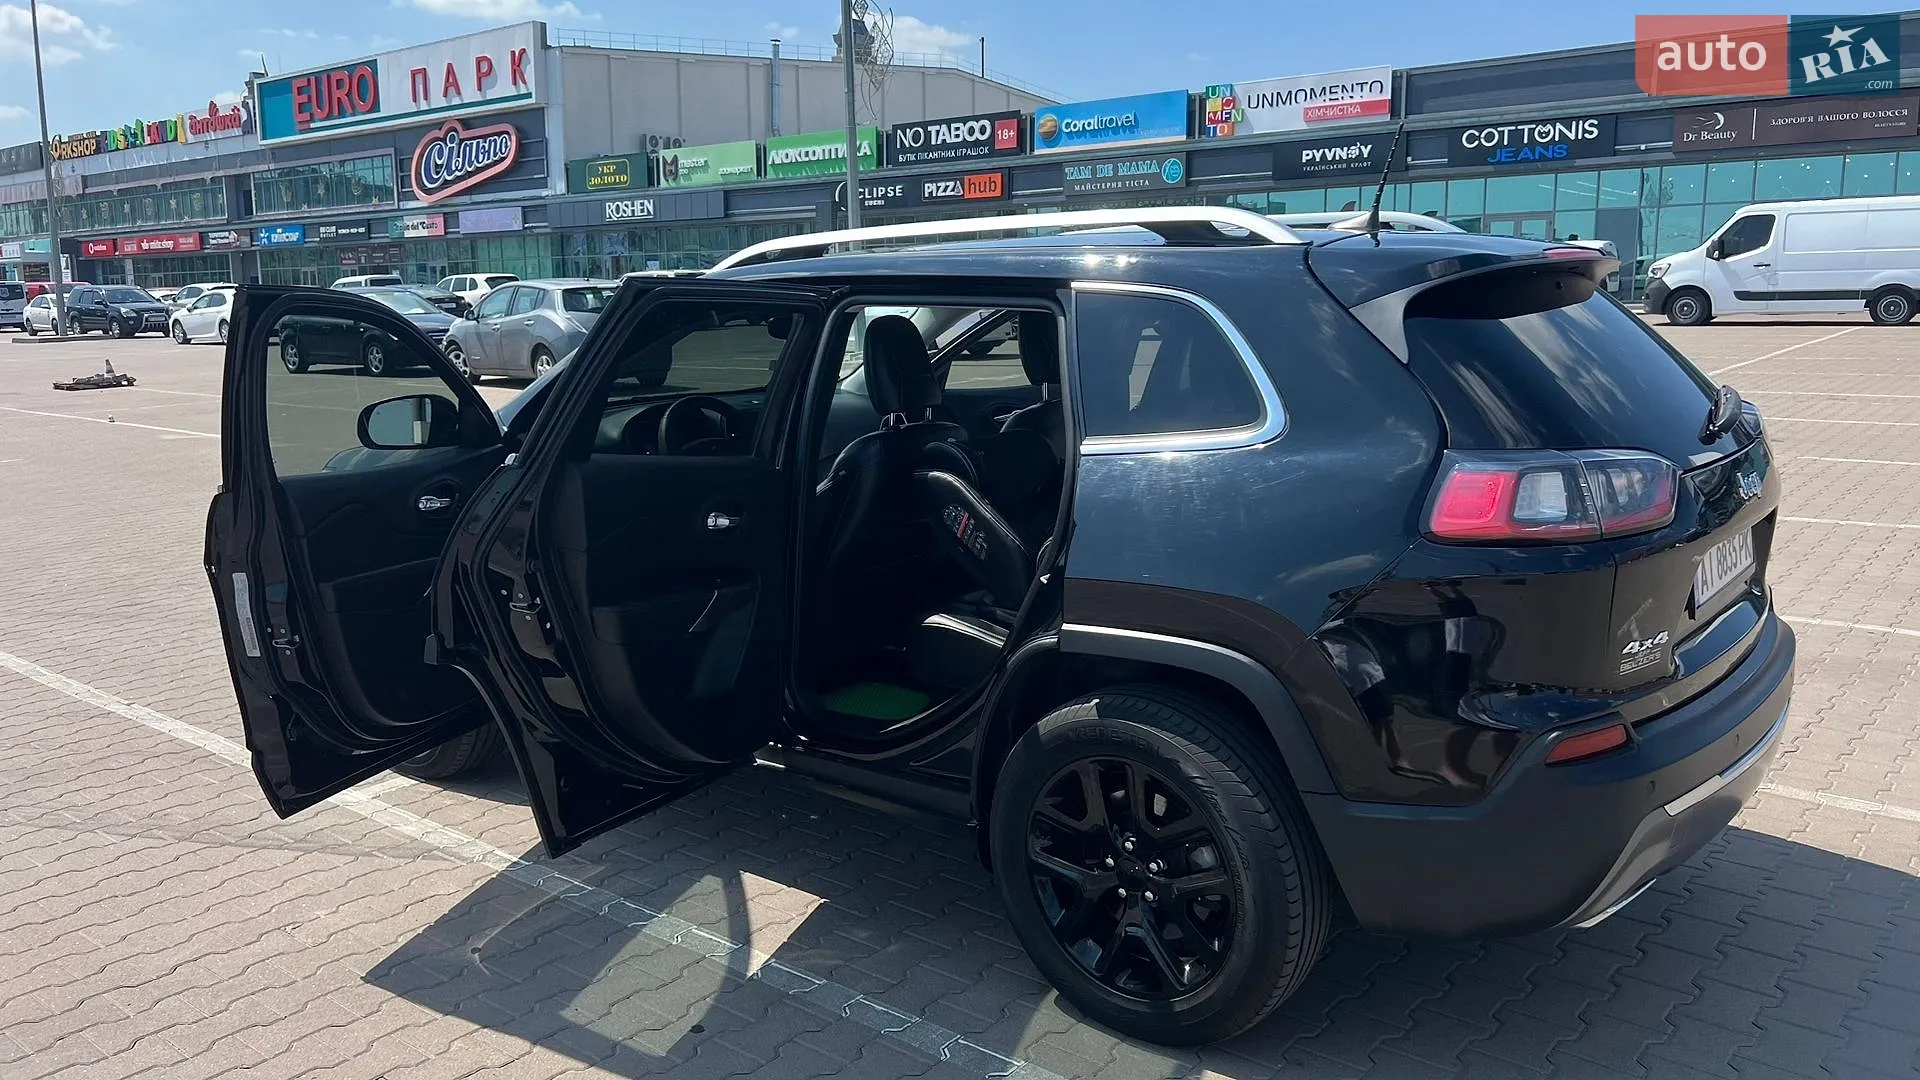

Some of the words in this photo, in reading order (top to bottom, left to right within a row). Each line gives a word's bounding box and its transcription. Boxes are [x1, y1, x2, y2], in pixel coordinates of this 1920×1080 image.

[410, 47, 527, 103] ПАРК
[292, 65, 378, 123] EURO
[1247, 80, 1383, 109] UNMOMENTO
[1306, 105, 1361, 118] ХІМЧИСТКА
[1817, 112, 1859, 122] ВАШОГО
[1862, 108, 1908, 119] ВОЛОССЯ
[896, 127, 925, 149] NO
[928, 119, 992, 145] TABOO
[997, 129, 1015, 140] 18+
[1461, 119, 1599, 148] COTTONIS
[1683, 132, 1697, 142] Dr
[1701, 130, 1738, 143] Beauty
[421, 131, 512, 188] Сільпо
[898, 153, 916, 162] БУТІК
[956, 146, 989, 157] ІГРАШОК
[1487, 144, 1569, 163] JEANS
[598, 165, 616, 174] УКР
[589, 175, 627, 185] ЗОЛОТО
[924, 181, 963, 197] PIZZA
[968, 176, 997, 194] hub
[1075, 181, 1122, 191] МАЙСТЕРНЯ
[1126, 179, 1149, 187] ТІСТА
[858, 185, 903, 199] CLIPSE
[605, 199, 655, 219] ROSHEN
[1737, 471, 1762, 499] Jeep
[1716, 537, 1738, 581] 8835
[1622, 631, 1669, 654] 4x4
